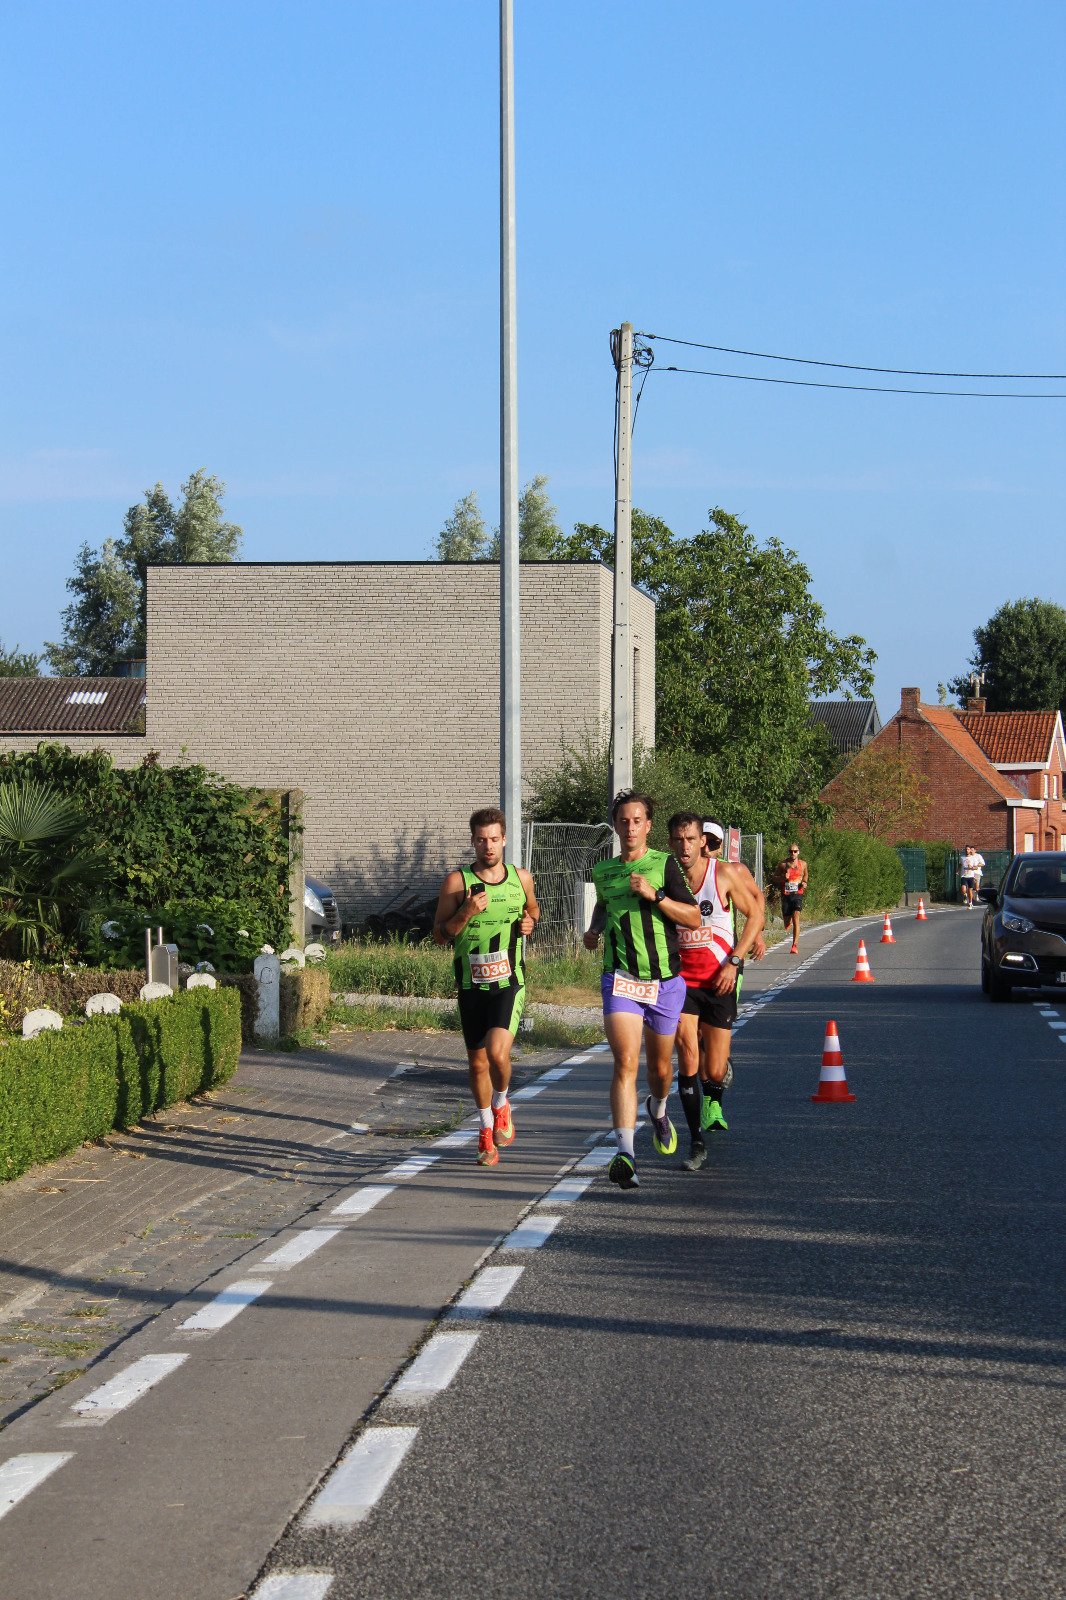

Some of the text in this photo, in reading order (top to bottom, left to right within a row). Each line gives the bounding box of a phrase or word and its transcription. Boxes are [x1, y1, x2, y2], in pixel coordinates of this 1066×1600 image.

[677, 929, 711, 943] 2002
[473, 962, 508, 977] 2036
[615, 980, 656, 997] 2003
